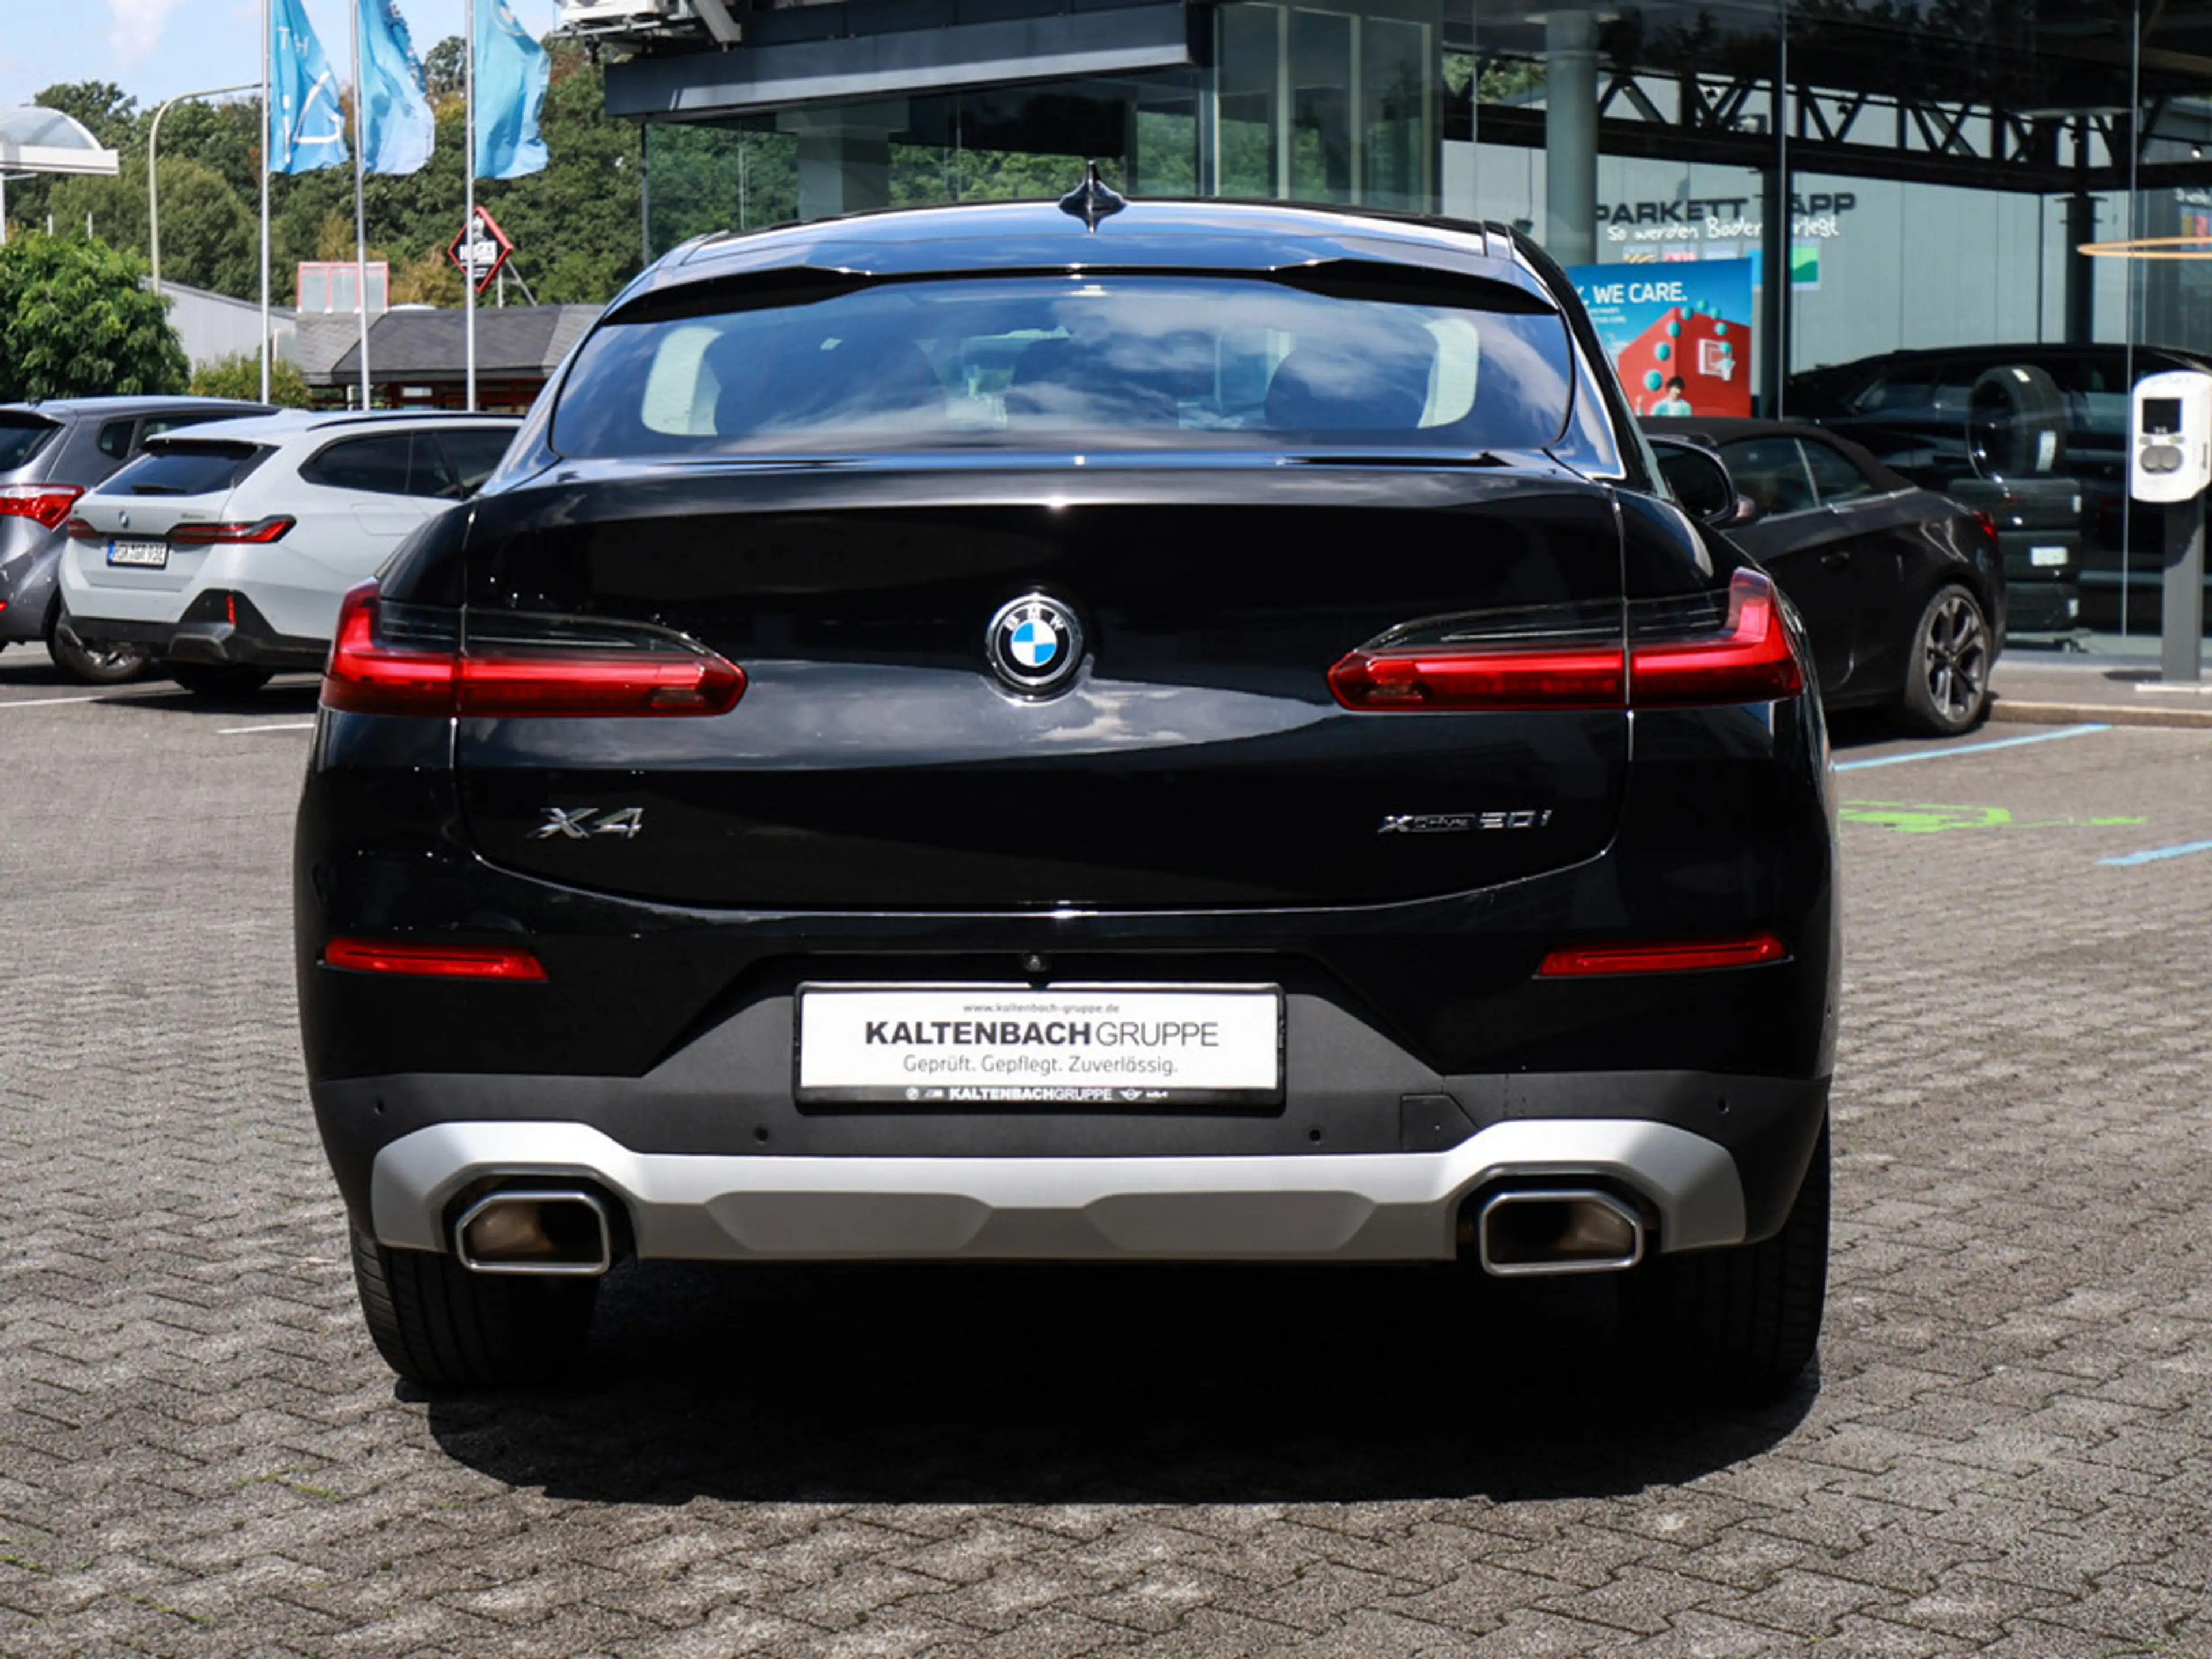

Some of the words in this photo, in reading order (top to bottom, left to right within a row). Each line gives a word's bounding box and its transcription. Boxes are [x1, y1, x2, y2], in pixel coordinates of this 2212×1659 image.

[1596, 199, 1748, 225] PARKETT
[1607, 225, 1627, 241] So
[1593, 283, 1625, 304] WE
[1628, 281, 1688, 304] CARE.
[527, 807, 644, 839] X4
[963, 1003, 1120, 1015] www.kaltenbach-gruppe.de
[903, 1054, 976, 1074] Geprüft.
[981, 1054, 1063, 1077] Gepflegt.
[1068, 1055, 1179, 1077] Zuverlässig.
